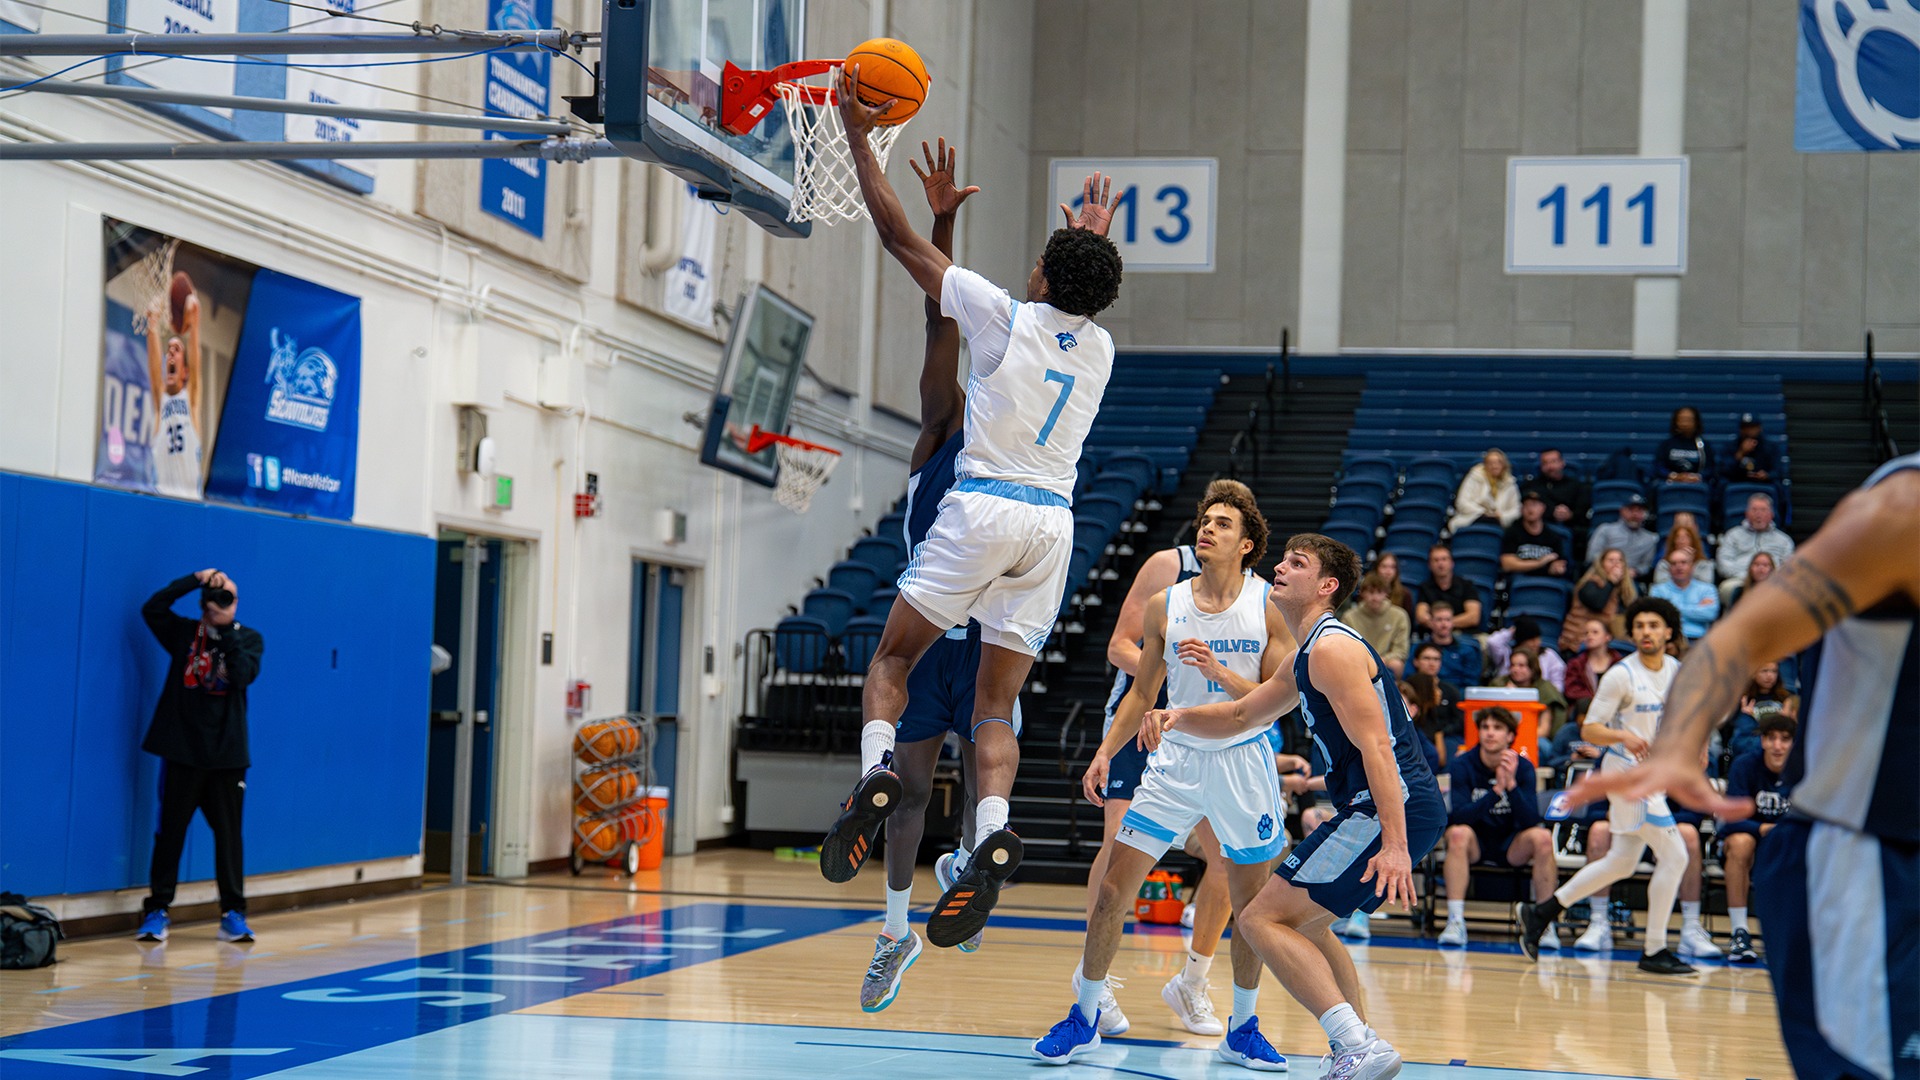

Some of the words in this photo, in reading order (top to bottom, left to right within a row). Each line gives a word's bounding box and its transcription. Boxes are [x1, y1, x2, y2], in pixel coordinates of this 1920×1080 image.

[1538, 183, 1655, 246] 111
[167, 423, 184, 454] 35
[1034, 368, 1075, 446] 7
[1172, 639, 1260, 655] SWOLVES
[281, 925, 786, 1008] STATE
